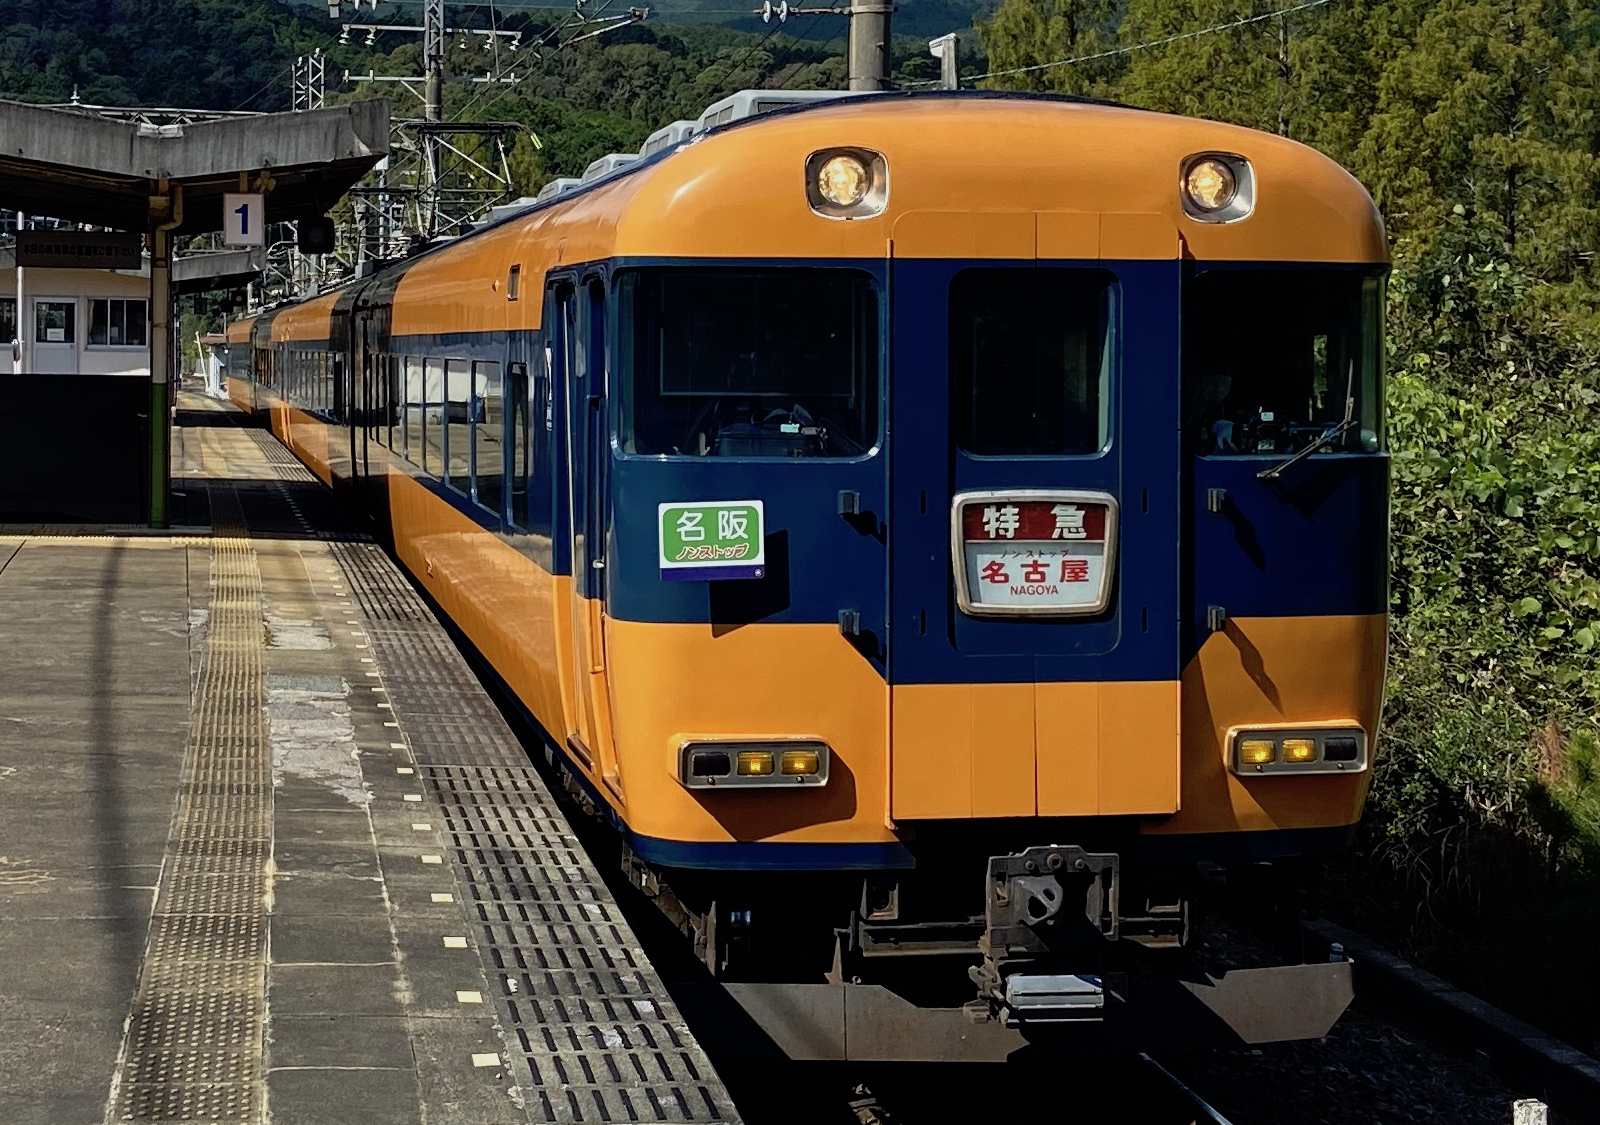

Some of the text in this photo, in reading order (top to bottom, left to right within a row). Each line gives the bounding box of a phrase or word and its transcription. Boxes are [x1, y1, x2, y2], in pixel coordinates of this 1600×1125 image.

[235, 204, 248, 234] 1
[676, 510, 748, 541] 名阪
[983, 504, 1087, 539] 特急
[675, 543, 749, 560] ノンストップ
[1000, 549, 1069, 558] ノンストップ
[980, 560, 1089, 583] 名古屋
[1010, 585, 1059, 595] NAGOYA
